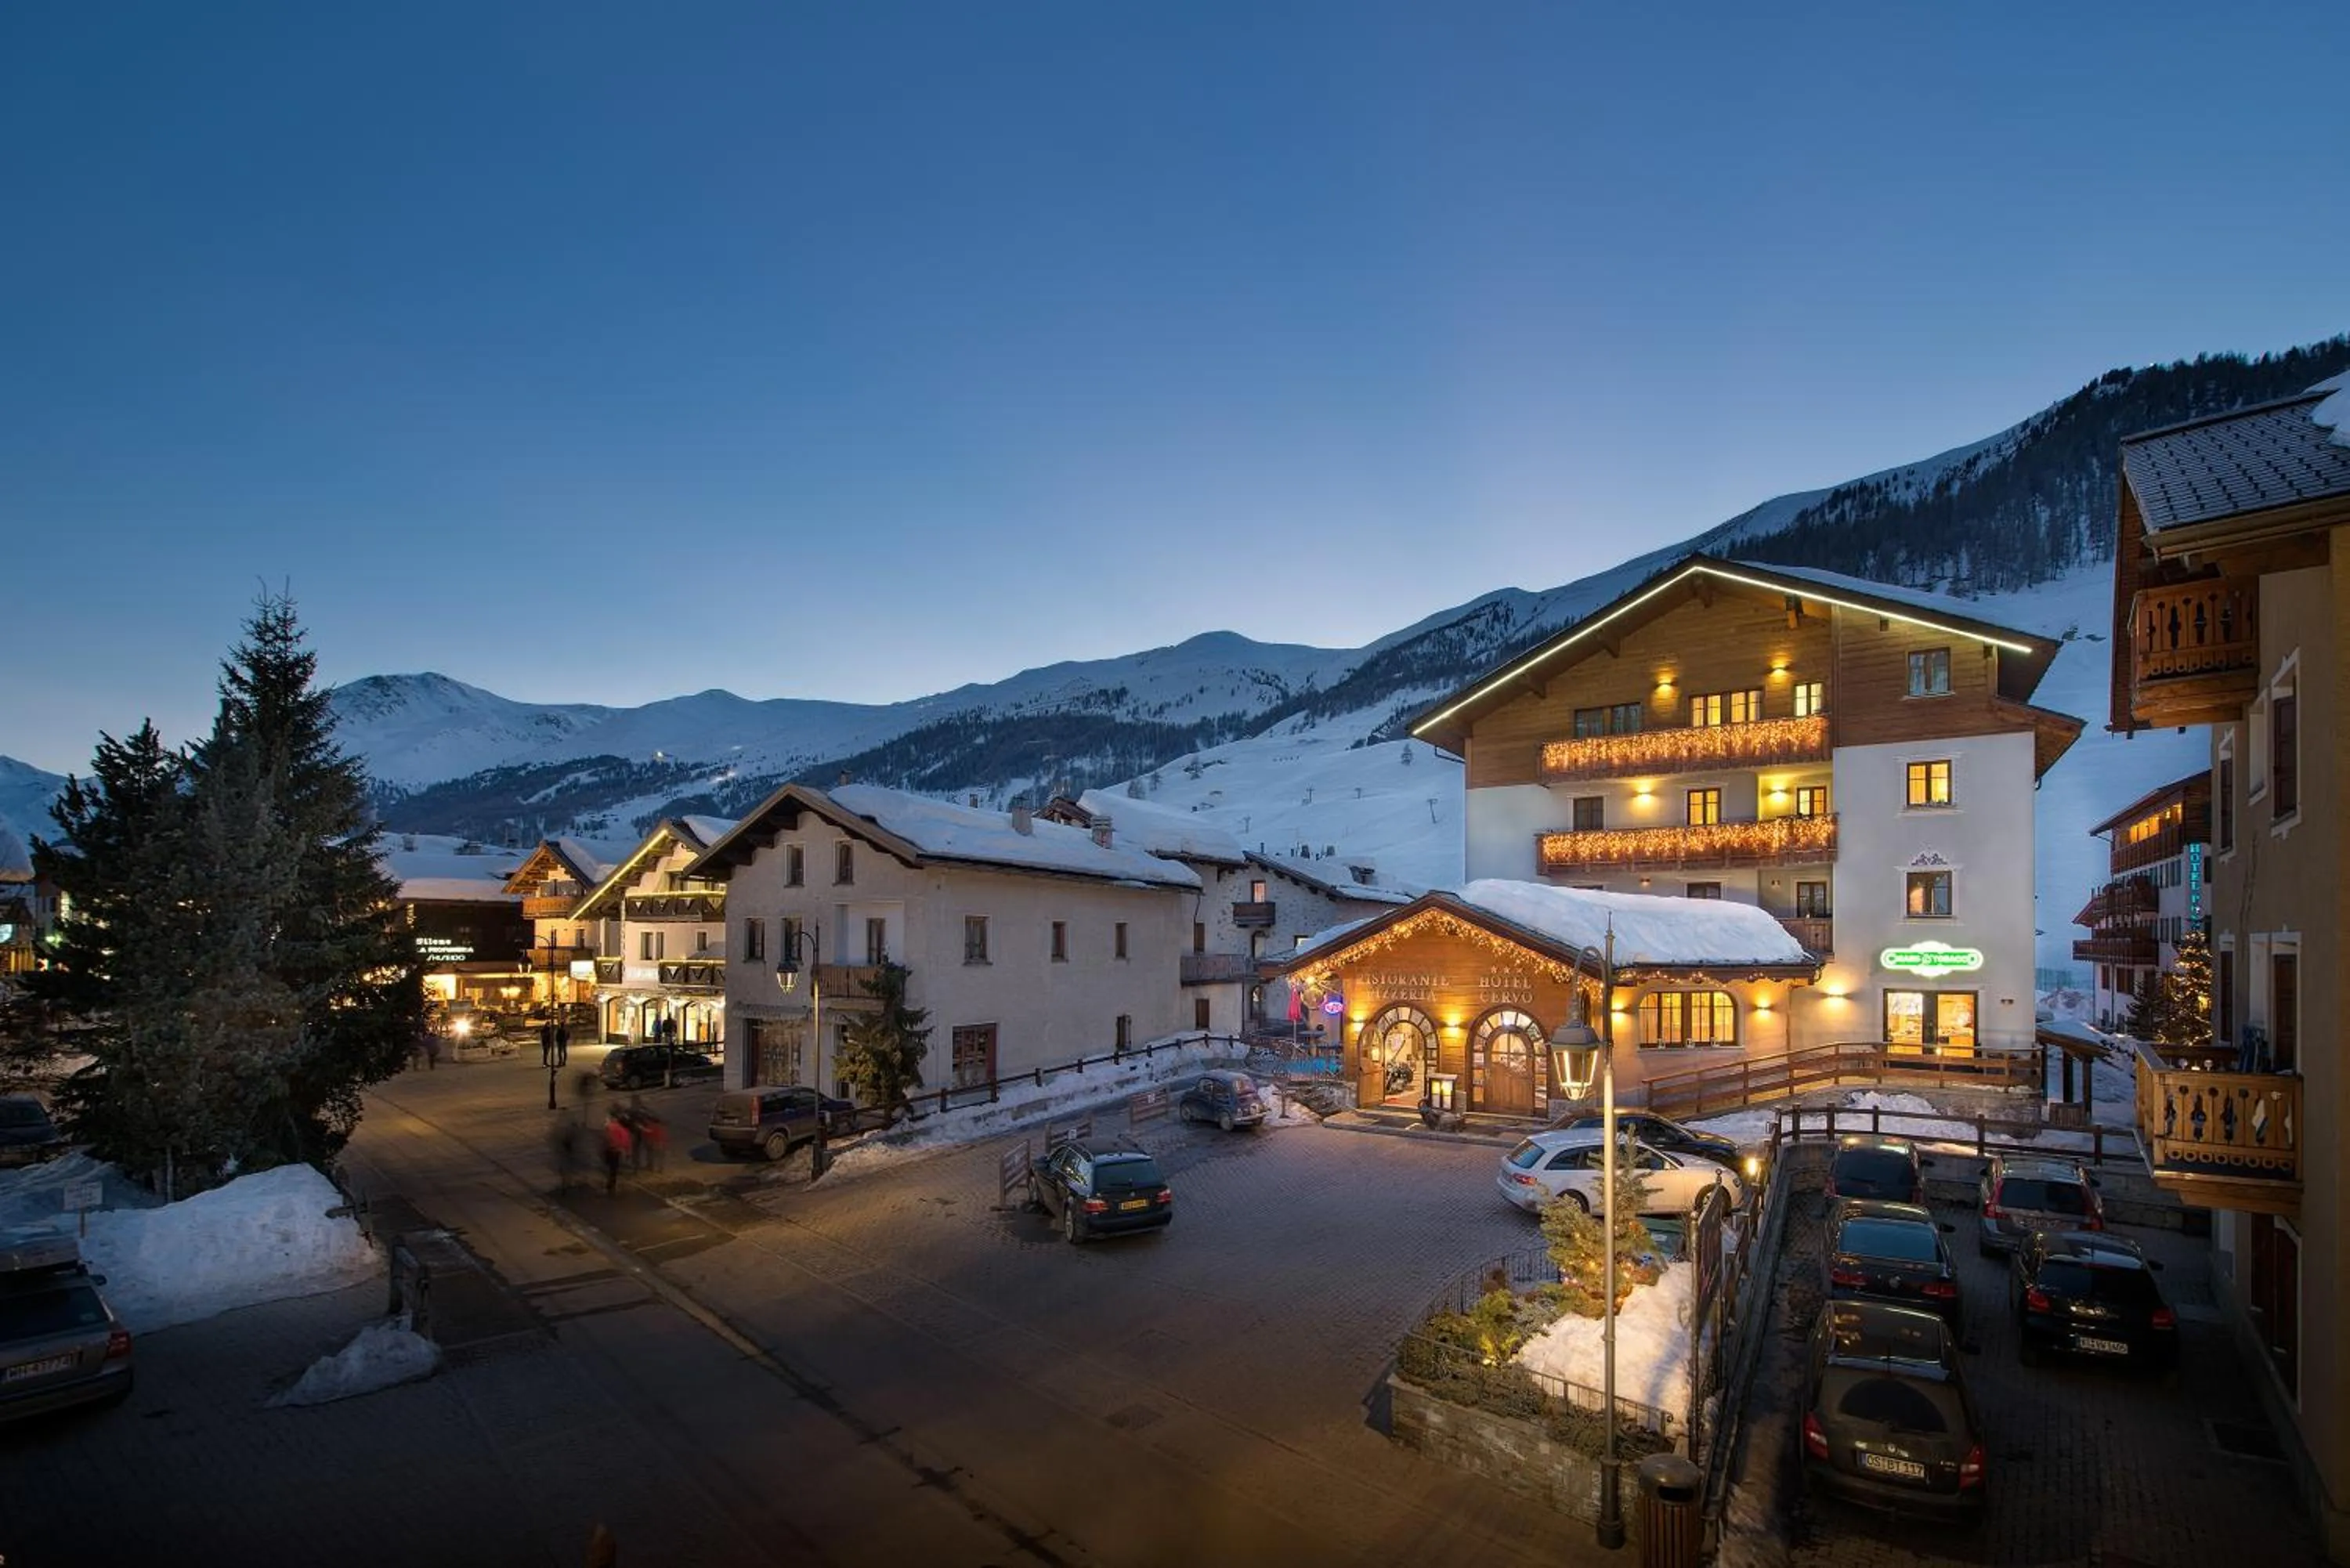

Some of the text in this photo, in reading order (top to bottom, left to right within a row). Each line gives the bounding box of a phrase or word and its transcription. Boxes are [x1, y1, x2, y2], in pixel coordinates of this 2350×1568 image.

[2189, 844, 2200, 891] HOTEL
[1478, 976, 1532, 988] HOTEL
[1366, 986, 1437, 1003] PIZZERIA
[1479, 991, 1534, 1003] CERVO
